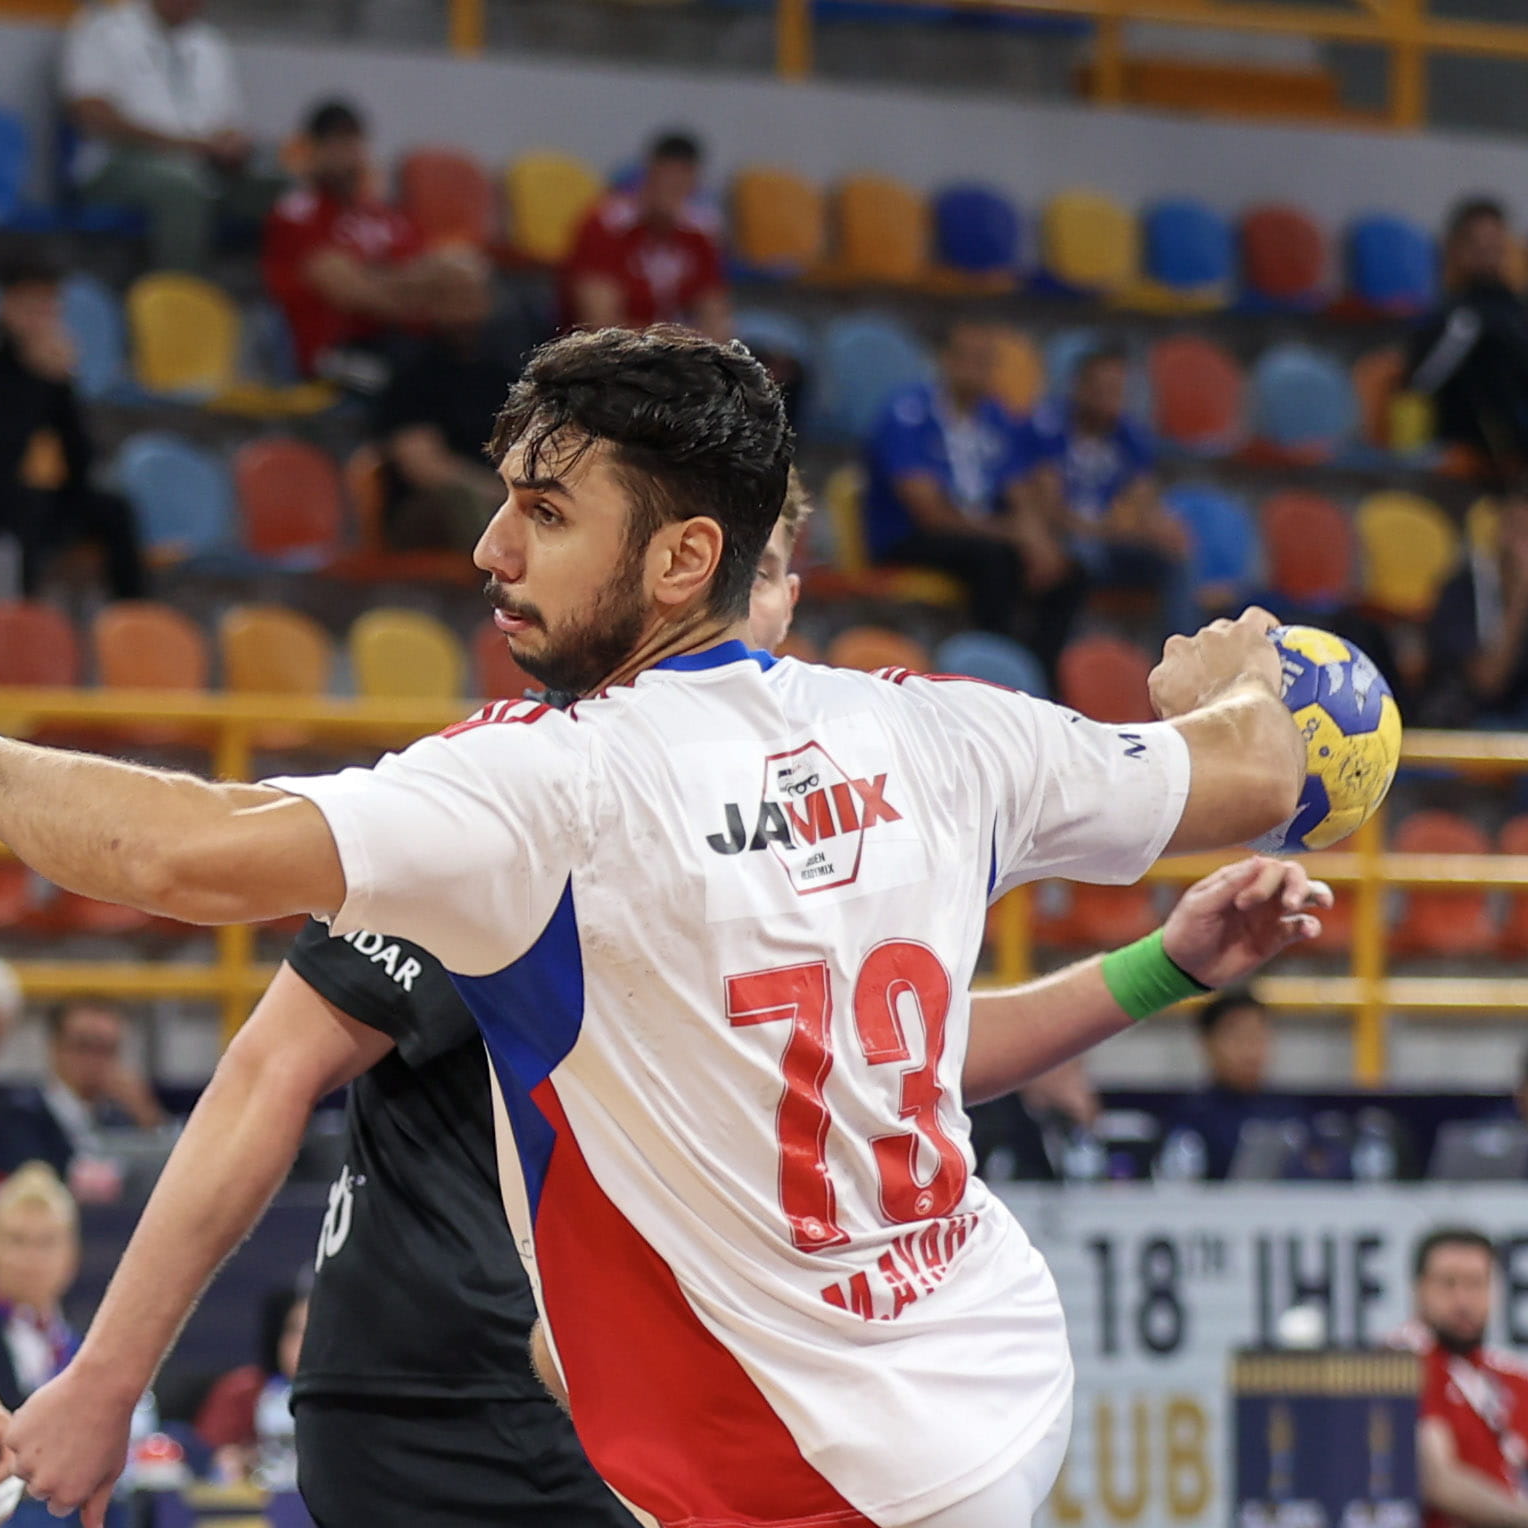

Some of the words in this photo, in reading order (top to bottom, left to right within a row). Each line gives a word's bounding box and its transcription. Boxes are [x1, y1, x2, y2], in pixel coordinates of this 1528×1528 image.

[706, 773, 903, 855] JAMIX
[343, 929, 422, 992] DAR
[724, 936, 970, 1253] 73
[1050, 1393, 1212, 1524] LUB
